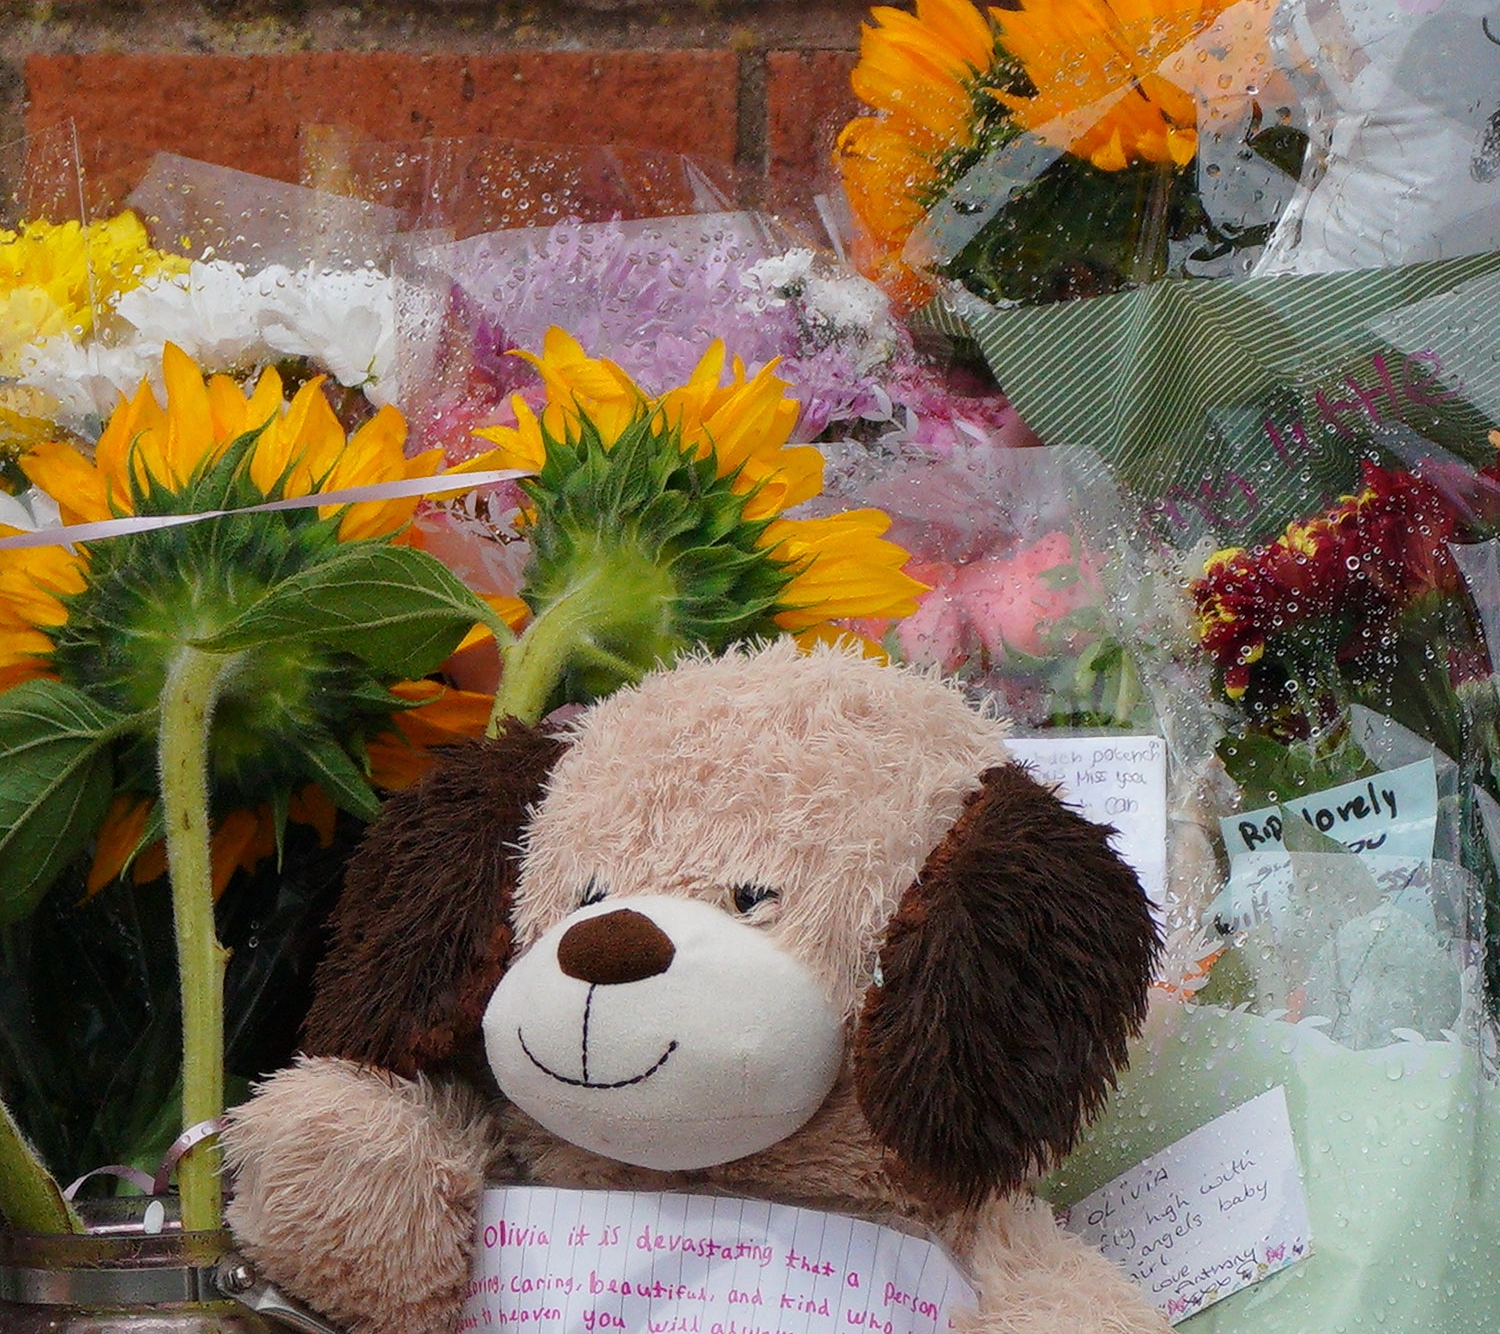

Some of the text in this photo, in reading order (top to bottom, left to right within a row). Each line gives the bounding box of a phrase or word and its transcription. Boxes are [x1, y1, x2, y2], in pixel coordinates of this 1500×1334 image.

[483, 1219, 551, 1249] Olivia
[567, 1224, 590, 1247] it
[598, 1224, 622, 1247] is
[636, 1225, 775, 1268] devastating
[785, 1247, 836, 1278] that
[846, 1271, 860, 1289] a
[499, 1306, 562, 1325] heaven
[582, 1309, 627, 1331] you
[648, 1314, 700, 1334] will
[728, 1287, 763, 1306] and
[847, 1308, 893, 1334] who
